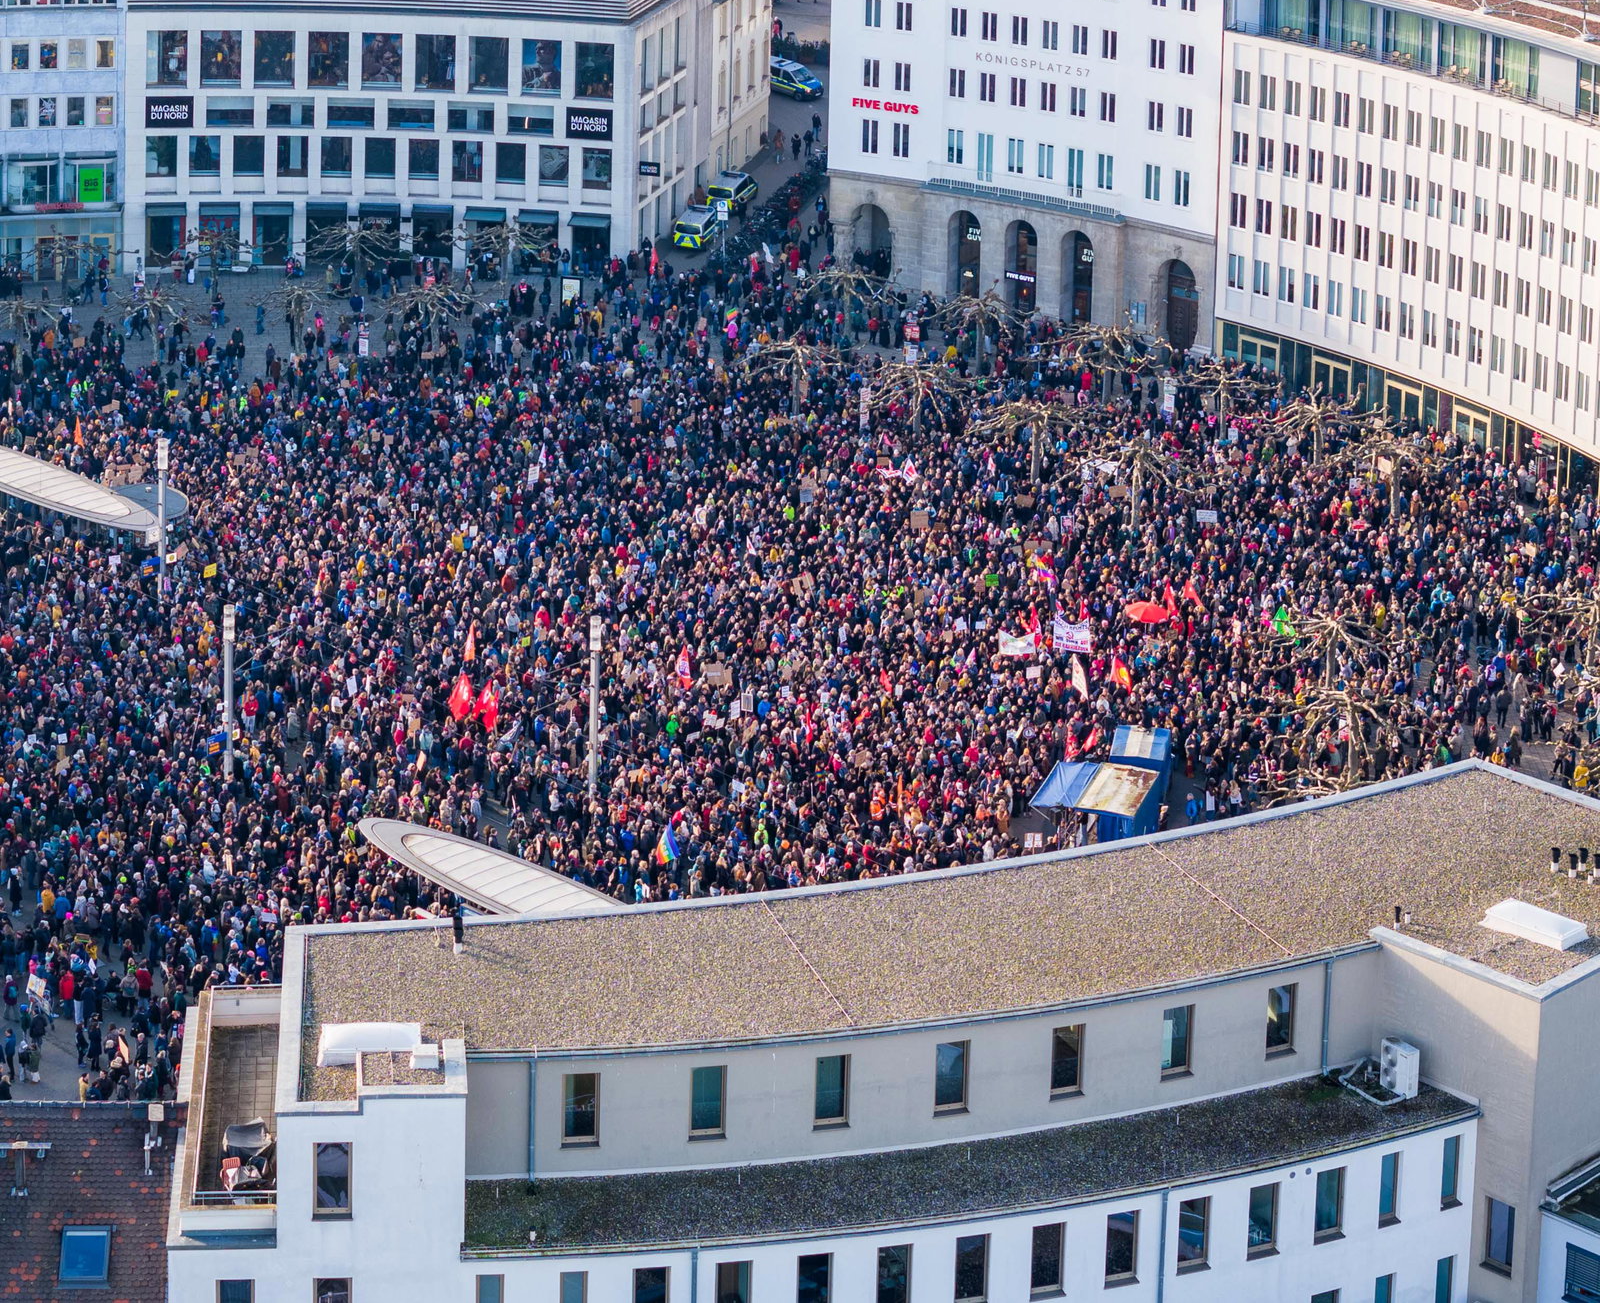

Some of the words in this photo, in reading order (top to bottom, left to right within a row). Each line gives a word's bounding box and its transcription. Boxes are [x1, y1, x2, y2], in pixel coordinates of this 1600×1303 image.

[975, 51, 1073, 75] KÖNIGSPLATZ
[1076, 67, 1091, 78] 57
[150, 104, 189, 112] MAGASIN
[852, 97, 881, 110] FIVE
[883, 101, 919, 115] GUYS
[150, 112, 162, 120] DU
[164, 112, 189, 120] NORD
[570, 115, 608, 125] MAGASIN
[570, 123, 582, 131] DU
[583, 124, 608, 132] NORD
[1006, 272, 1018, 280] FIVE
[1018, 274, 1035, 283] GUYS
